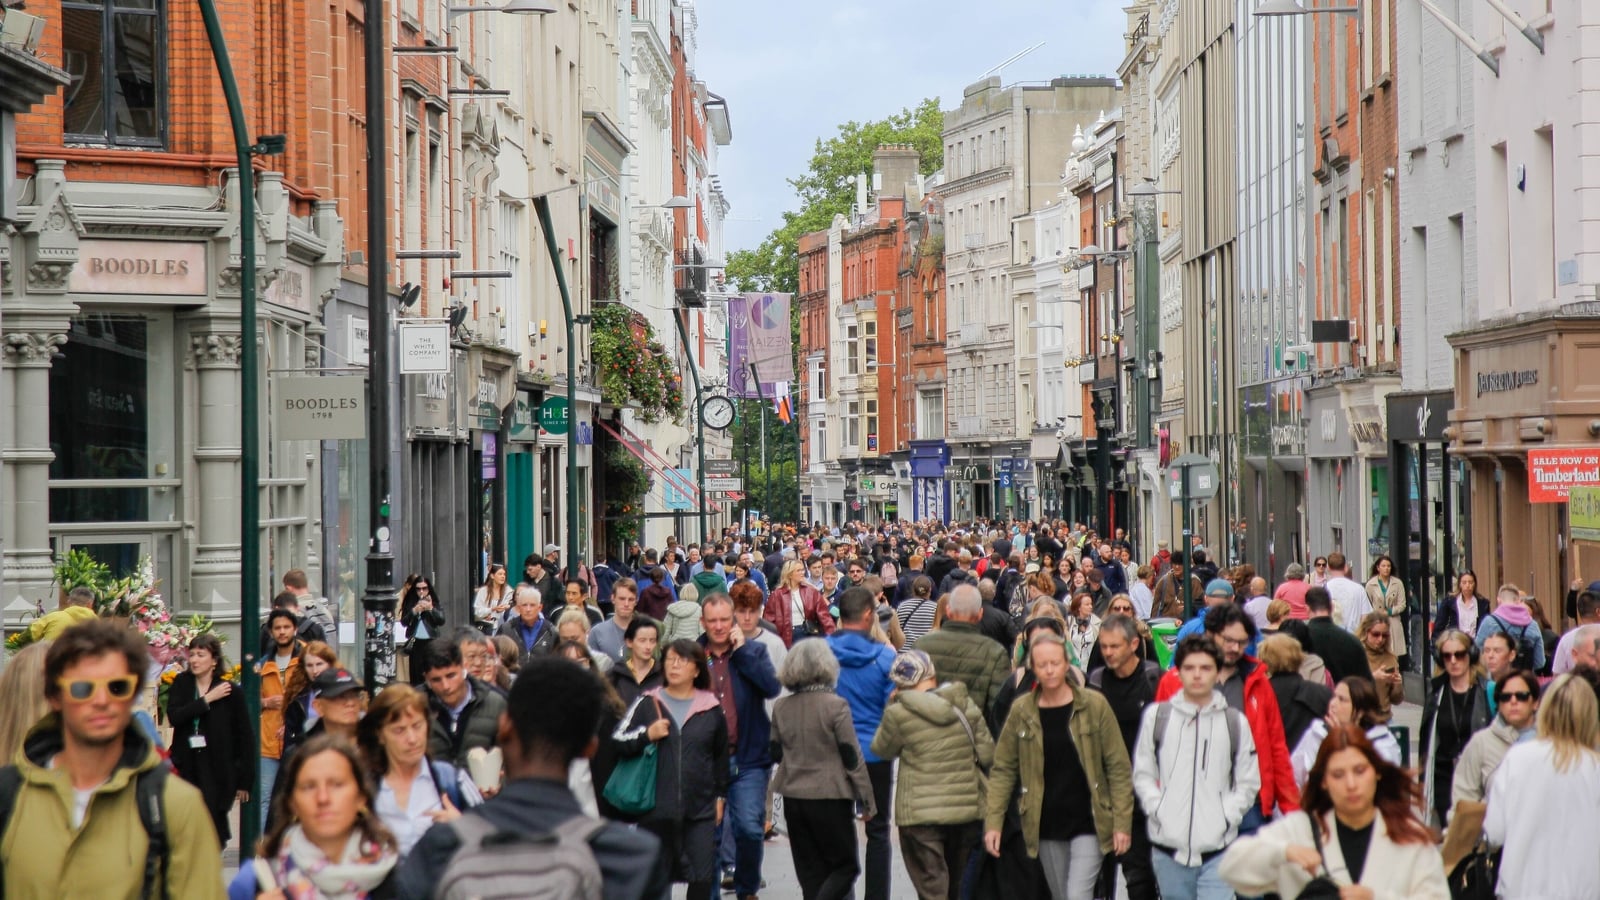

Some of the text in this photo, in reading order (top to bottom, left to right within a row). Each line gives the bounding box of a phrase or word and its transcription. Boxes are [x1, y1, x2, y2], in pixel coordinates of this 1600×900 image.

[90, 257, 189, 277] BOODLES
[750, 336, 789, 347] KAIZEN
[285, 398, 358, 410] BOODLES
[311, 412, 333, 420] 1798
[1533, 457, 1557, 465] SALE
[1559, 457, 1582, 465] NOW
[1533, 467, 1600, 483] Timberland
